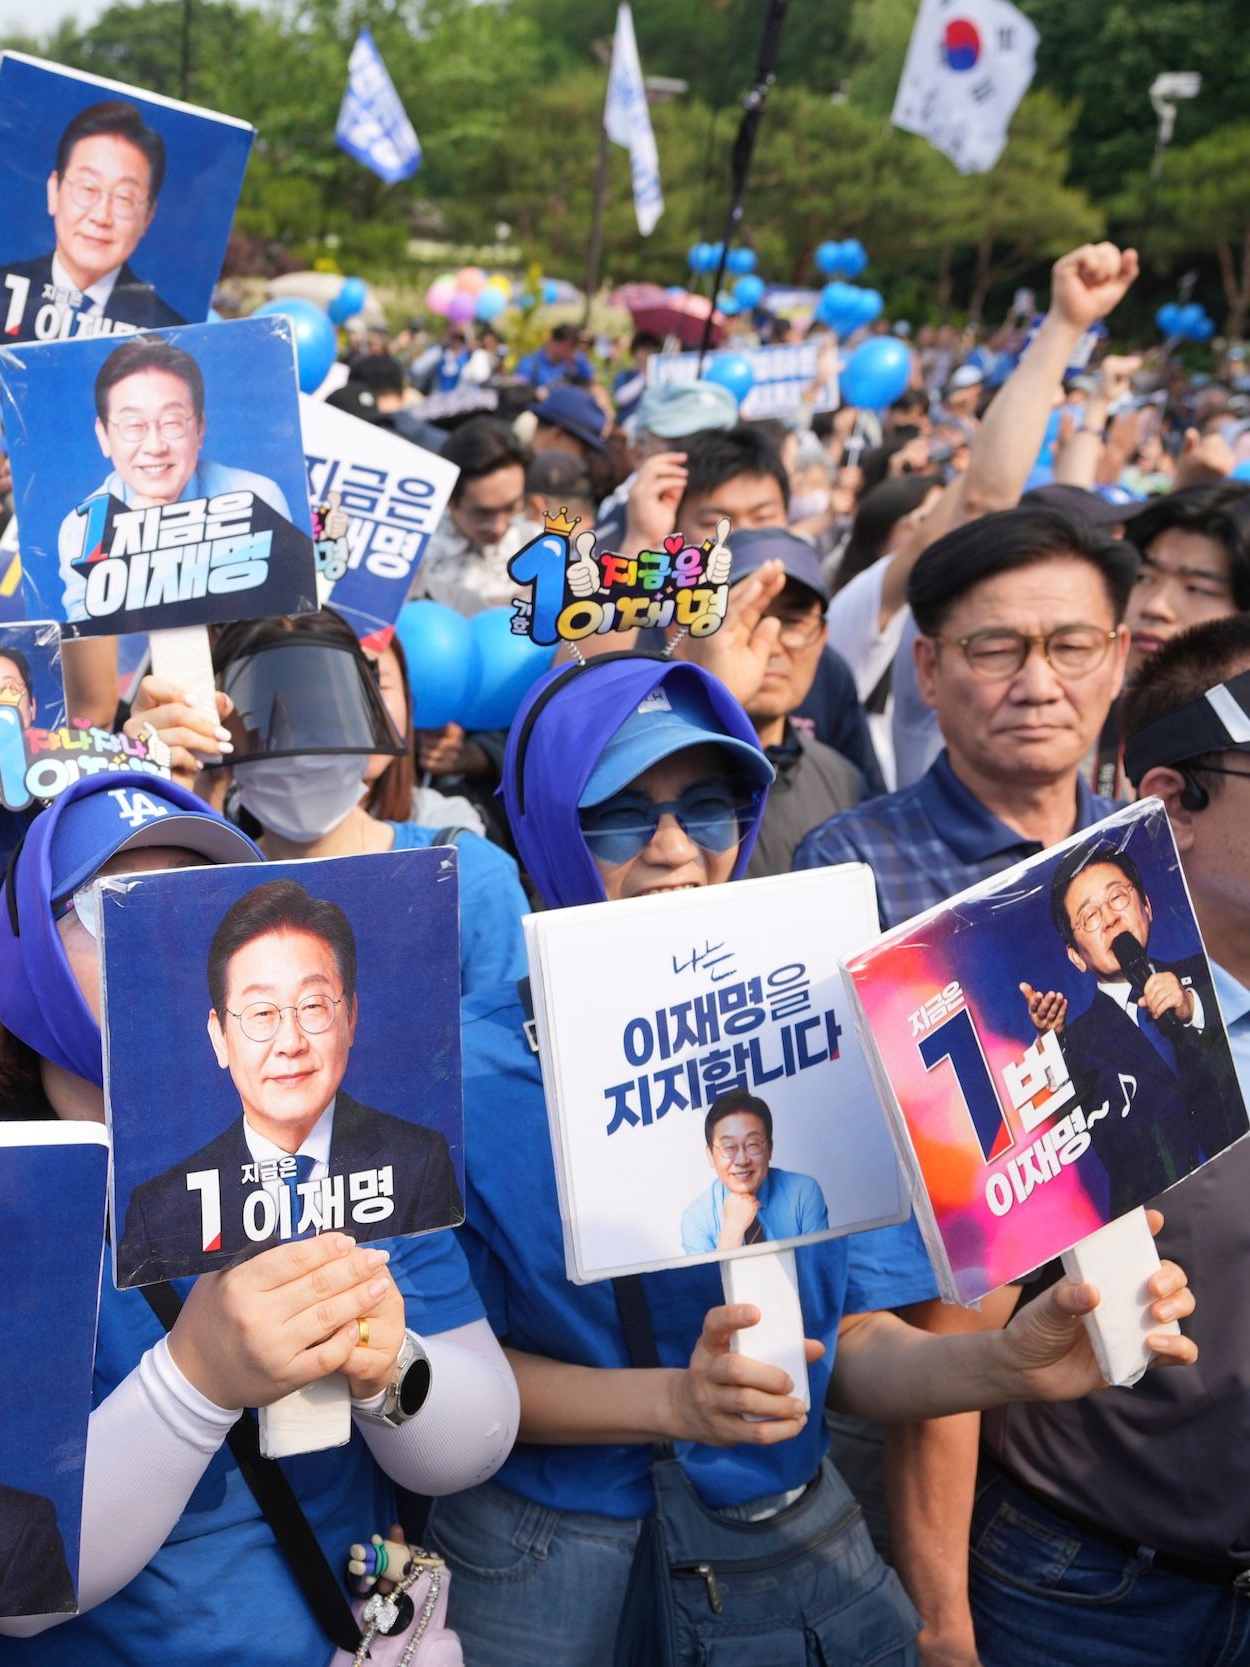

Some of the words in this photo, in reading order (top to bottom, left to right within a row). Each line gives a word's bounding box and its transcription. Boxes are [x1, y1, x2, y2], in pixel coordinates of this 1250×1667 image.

[4, 273, 31, 336] 1
[73, 494, 110, 565] 1
[108, 491, 254, 558] 지금은
[85, 530, 273, 617] 이재명
[509, 533, 568, 644] 1
[601, 548, 702, 590] 지금은
[511, 600, 532, 635] 기호
[557, 585, 730, 641] 이재명
[108, 789, 168, 827] LA
[672, 940, 737, 981] 나는
[623, 962, 811, 1067] 이재명을
[906, 980, 966, 1038] 지금은
[604, 1009, 842, 1136] 지지합니다
[186, 1169, 221, 1252] 1
[241, 1156, 297, 1185] 지금은
[242, 1165, 395, 1242] 이재명
